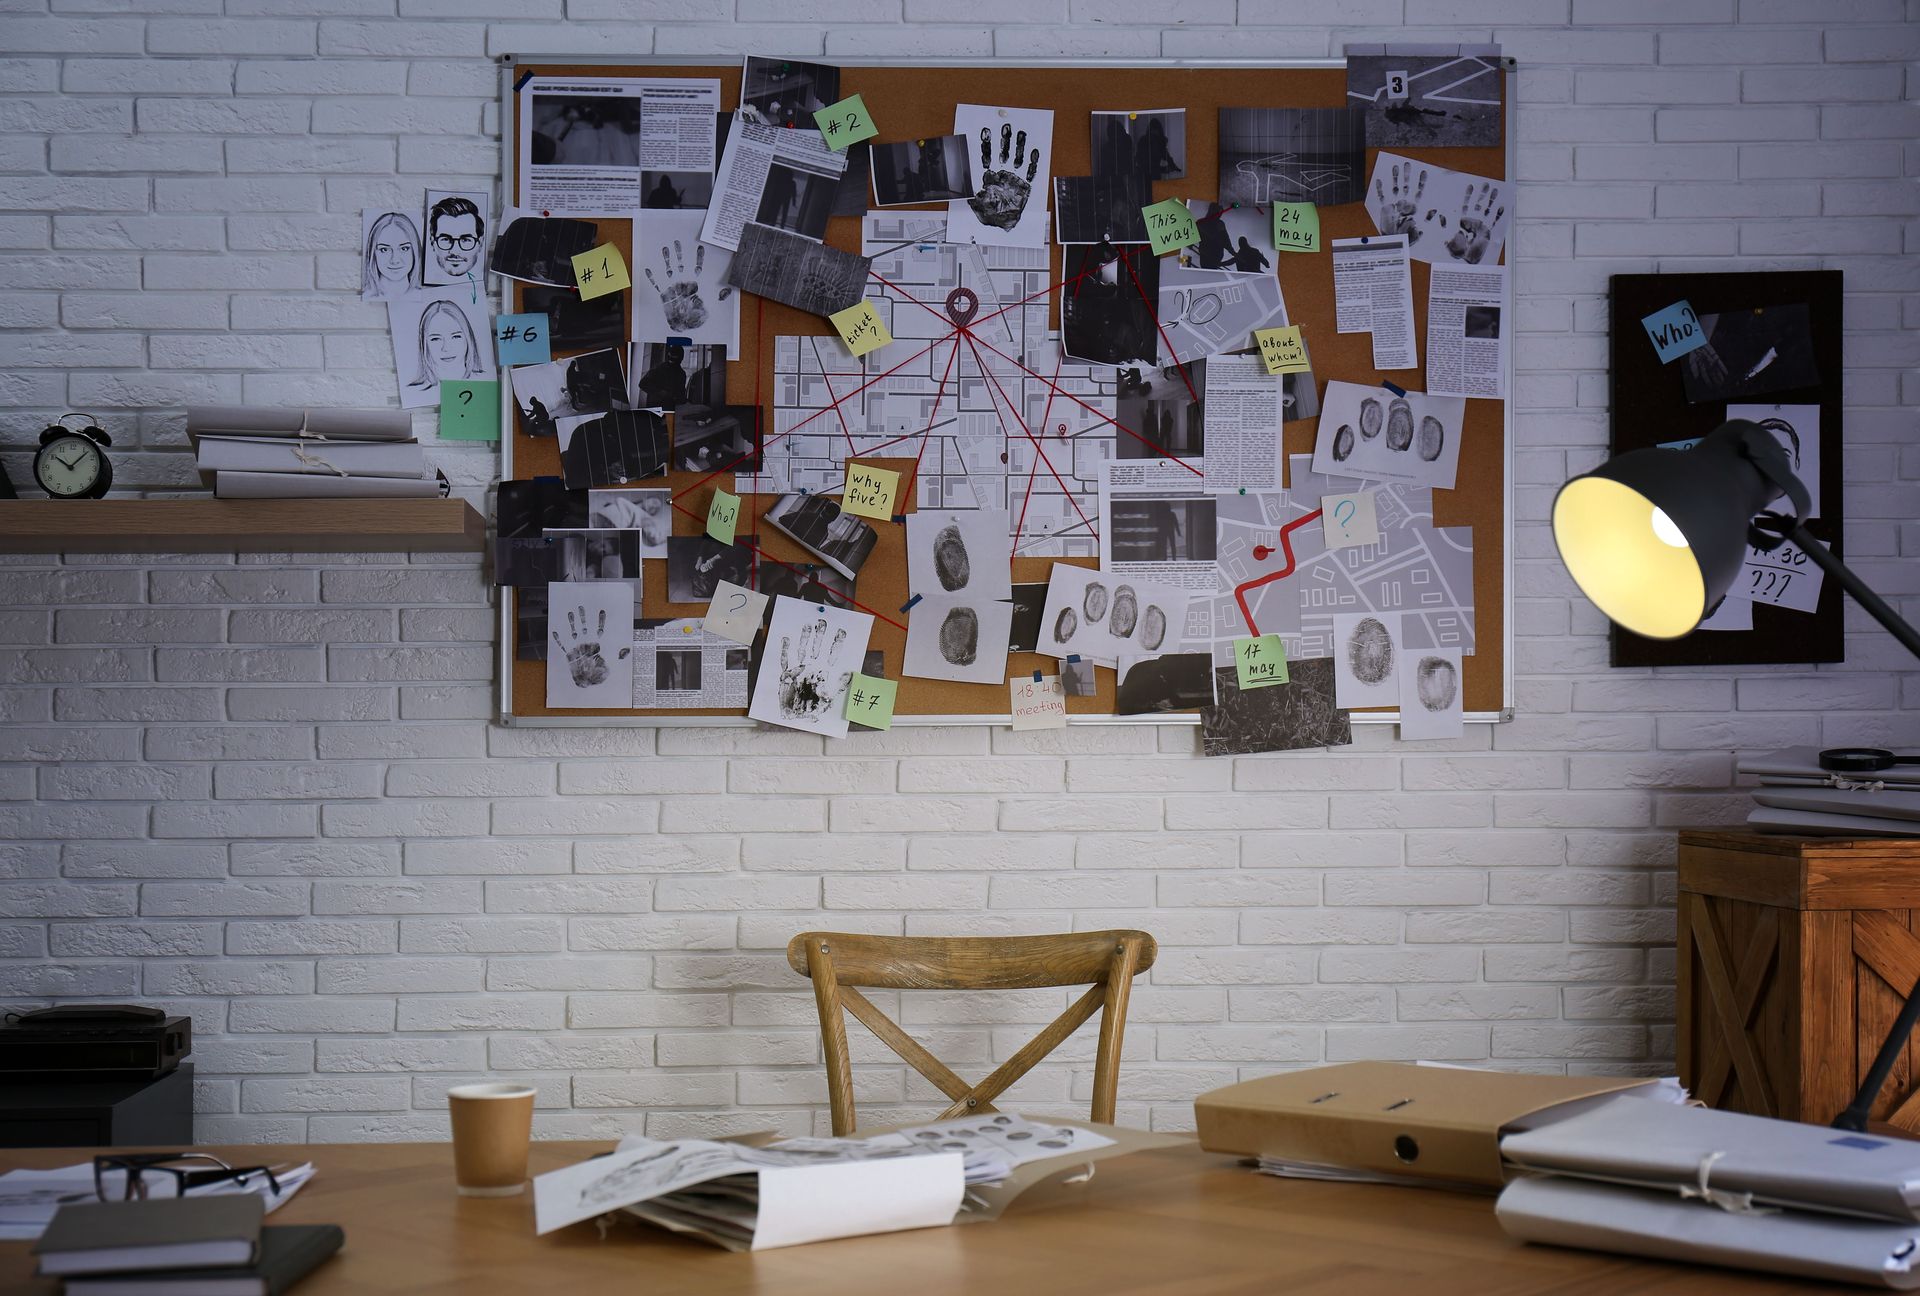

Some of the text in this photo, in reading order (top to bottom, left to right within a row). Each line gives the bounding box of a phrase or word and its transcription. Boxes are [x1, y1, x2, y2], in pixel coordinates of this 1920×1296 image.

[1392, 76, 1403, 93] 3
[1149, 213, 1177, 229] This
[1281, 208, 1300, 224] 24
[1160, 218, 1195, 245] way?
[1280, 228, 1313, 246] may
[846, 311, 872, 345] ticket
[869, 325, 881, 341] ?
[1651, 307, 1699, 350] Who?
[1262, 336, 1295, 348] about
[458, 390, 473, 418] ?
[848, 488, 888, 510] five?
[1334, 500, 1355, 538] ?
[1750, 570, 1792, 603] ???
[726, 593, 747, 625] ?
[1244, 644, 1261, 660] 17
[1249, 663, 1275, 676] may
[1015, 700, 1065, 717] meeting
